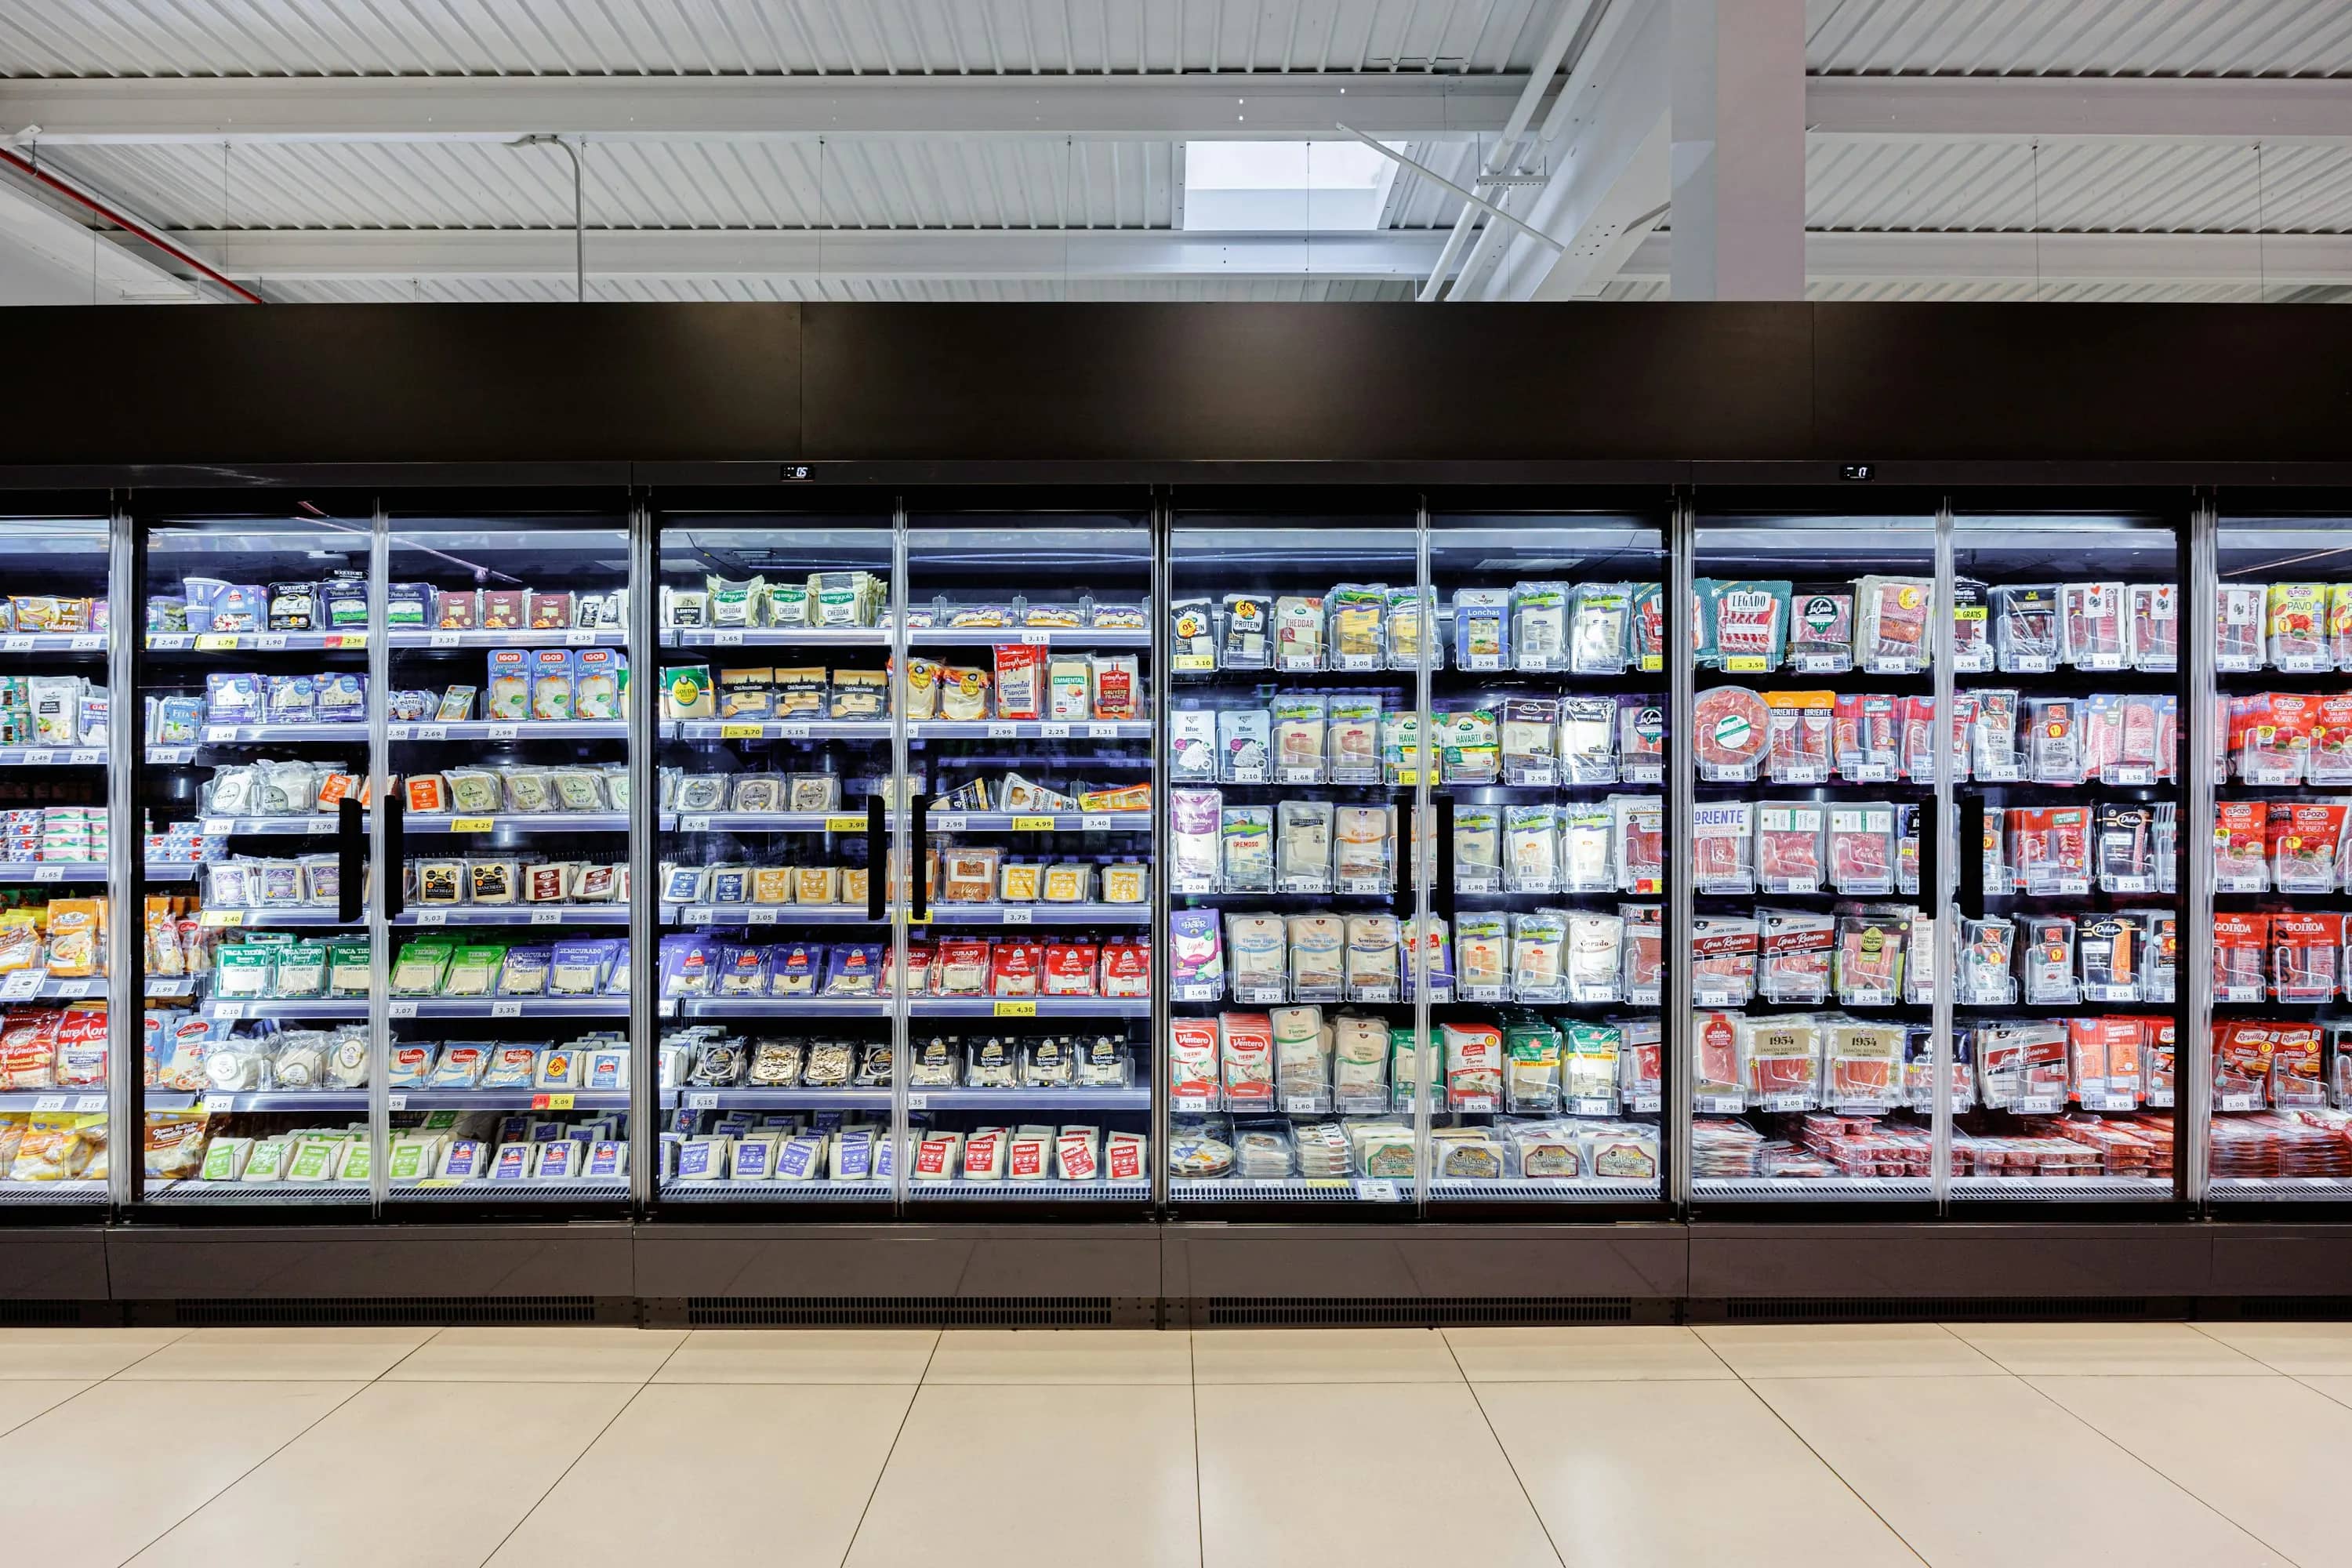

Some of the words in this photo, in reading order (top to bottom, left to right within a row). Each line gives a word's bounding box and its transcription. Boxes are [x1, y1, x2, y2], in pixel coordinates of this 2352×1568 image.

[1732, 595, 1766, 607] LEGADO
[2287, 601, 2311, 611] PAVO
[1235, 620, 1260, 629] PROTEIN
[1287, 619, 1314, 628] CHEDDAR
[1000, 681, 1029, 690] Emmental
[1004, 688, 1029, 697] Français
[1456, 734, 1481, 743] HAVARTI
[2214, 922, 2251, 933] GOIKOA
[2286, 922, 2325, 932] GOIKOA
[1178, 1034, 1209, 1044] Ventero
[1769, 1036, 1795, 1046] 1954
[1851, 1037, 1877, 1047] 1954
[2237, 1032, 2267, 1042] Revilla
[2283, 1032, 2308, 1043] Revilla
[1232, 1038, 1263, 1048] Ventero
